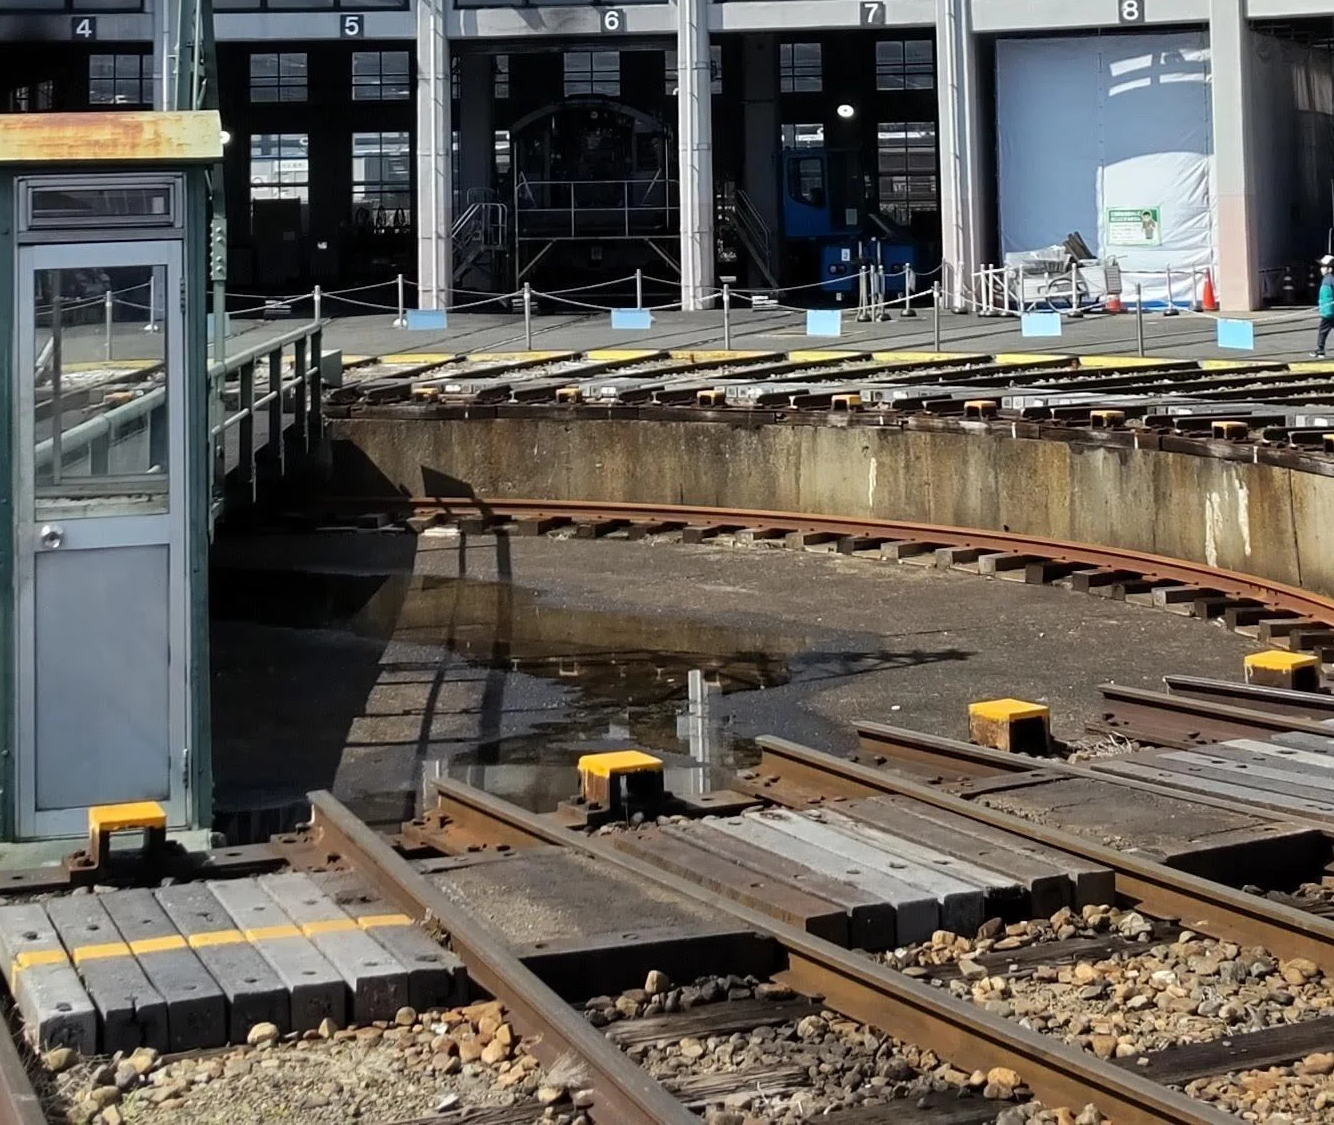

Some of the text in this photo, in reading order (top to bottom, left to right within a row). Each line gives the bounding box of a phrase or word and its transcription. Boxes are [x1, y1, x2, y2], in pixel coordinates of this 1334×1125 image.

[604, 10, 619, 30] 6
[864, 3, 879, 23] 7
[1122, 0, 1139, 20] 8
[76, 18, 92, 37] 4
[345, 16, 359, 35] 5
